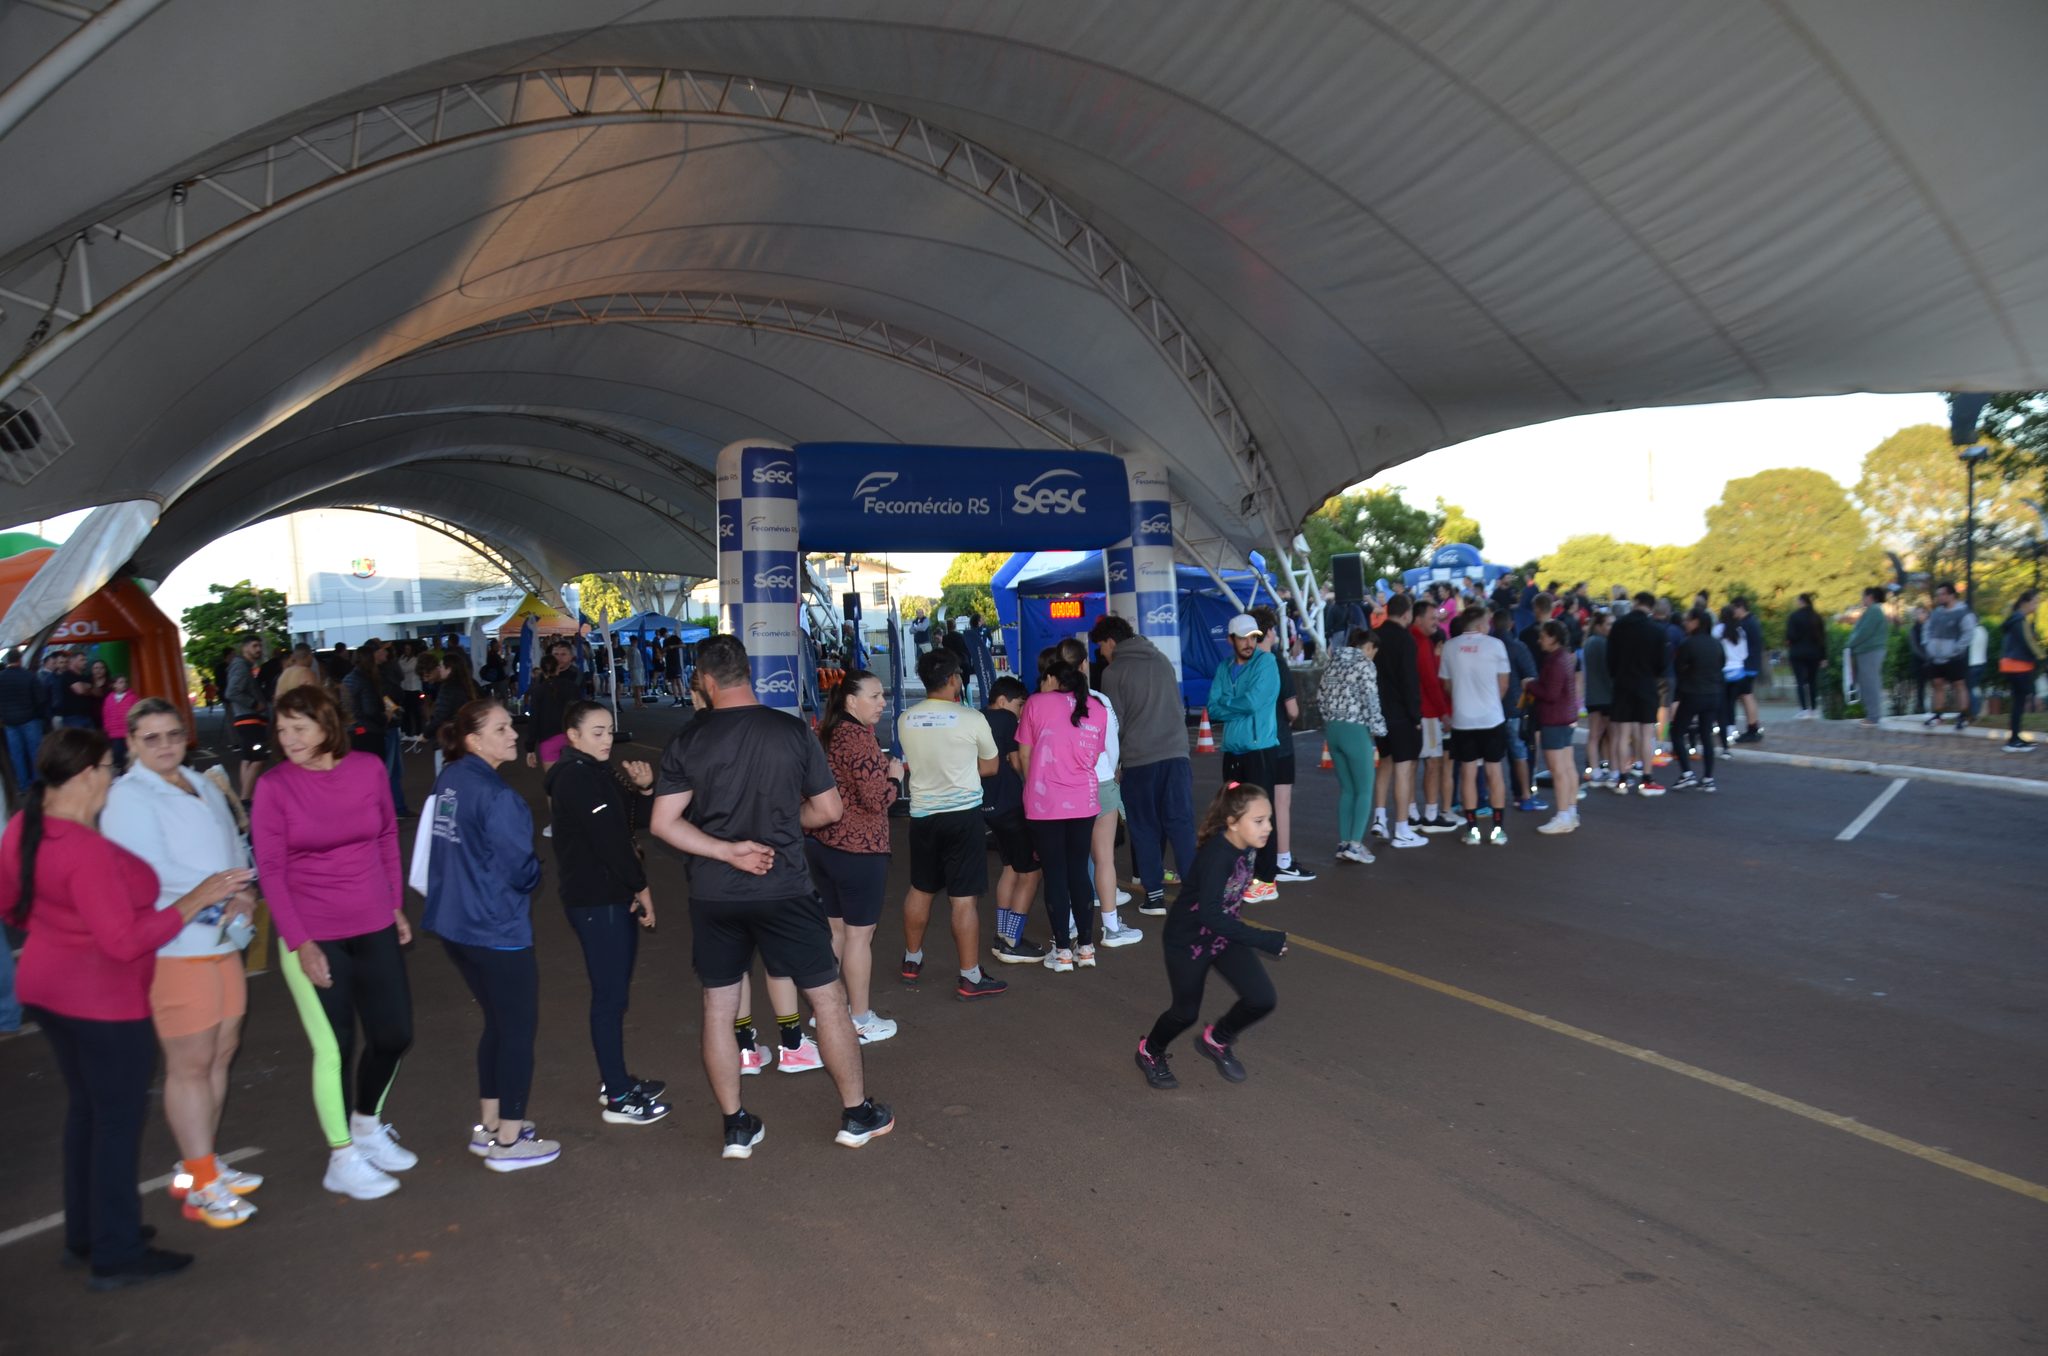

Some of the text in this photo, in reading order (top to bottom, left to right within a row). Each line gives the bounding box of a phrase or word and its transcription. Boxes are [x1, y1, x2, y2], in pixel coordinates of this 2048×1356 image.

[864, 496, 990, 514] Fecomércio RS
[1012, 484, 1087, 514] Sesc
[753, 571, 794, 588] Sesc
[1108, 568, 1128, 581] esc
[755, 678, 795, 694] Sesc
[620, 1104, 644, 1115] FILA
